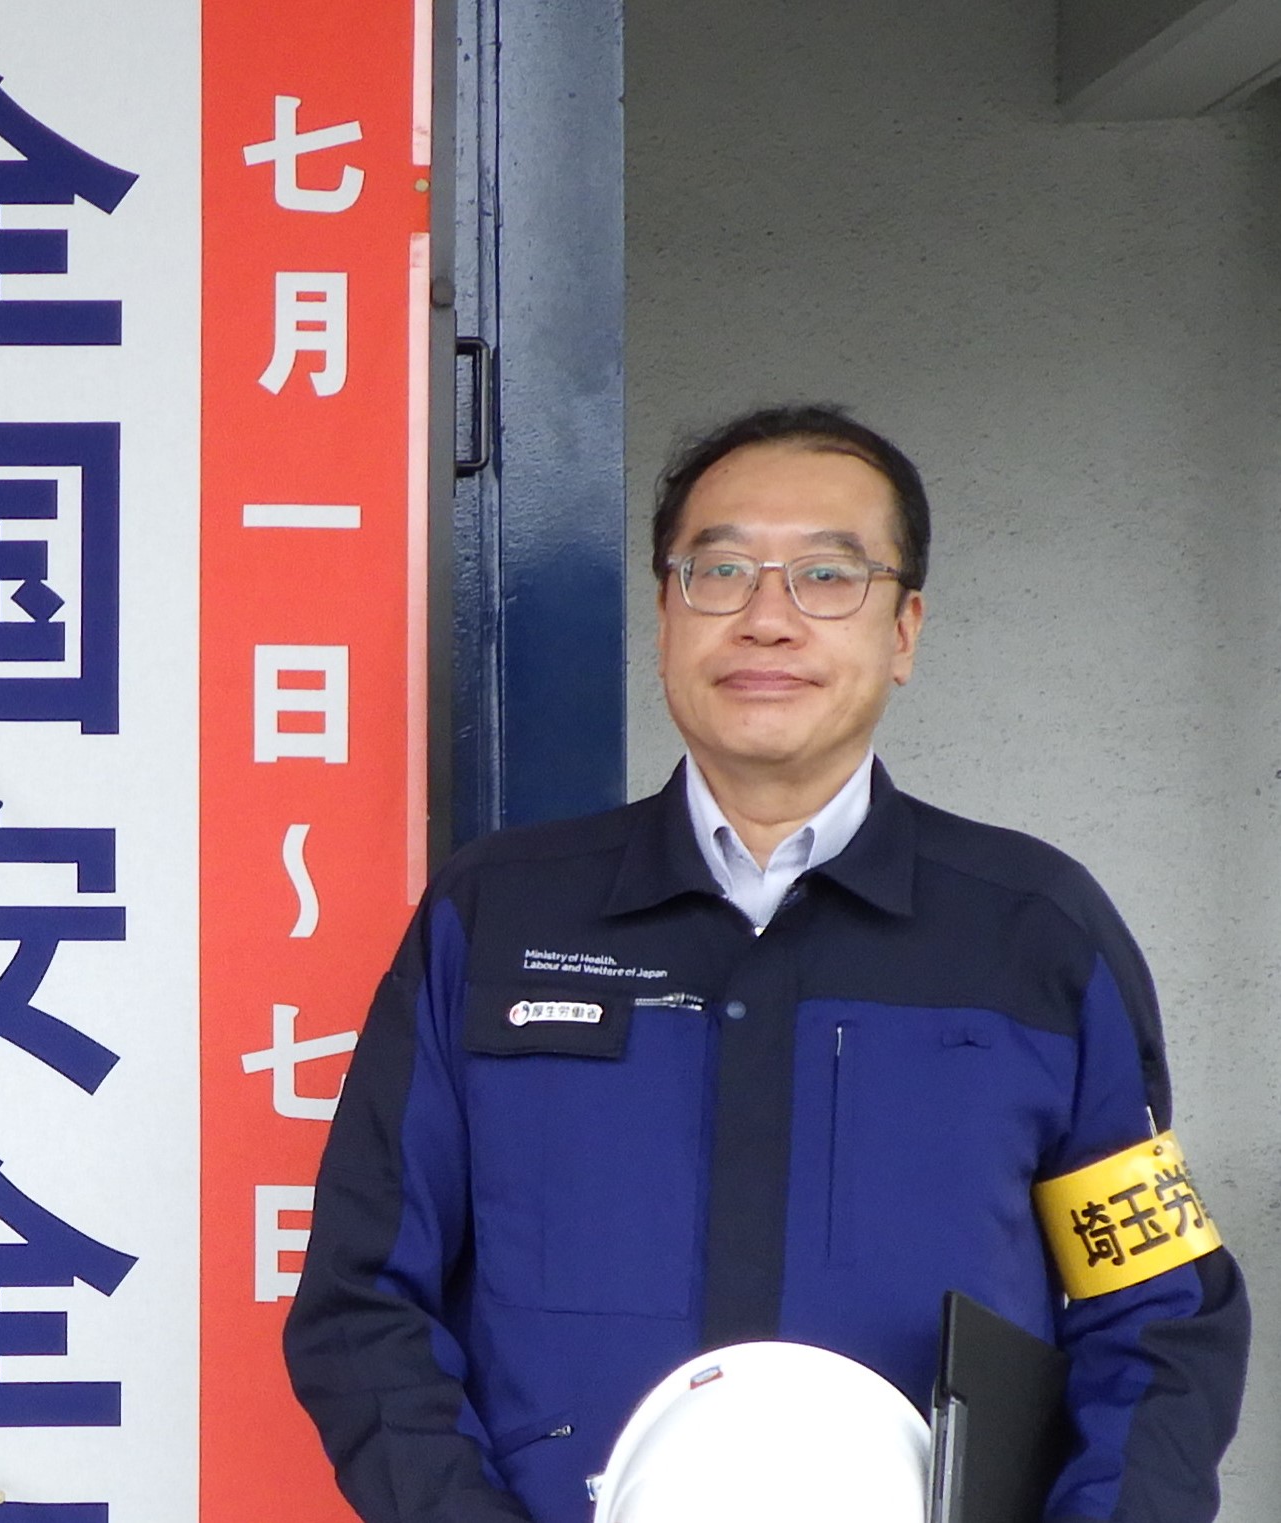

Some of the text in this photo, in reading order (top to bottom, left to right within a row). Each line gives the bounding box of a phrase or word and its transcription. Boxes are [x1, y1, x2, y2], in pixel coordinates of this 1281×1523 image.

[524, 948, 569, 963] Ministry
[568, 953, 579, 963] of
[523, 959, 668, 980] Labour and Welfare of Japan
